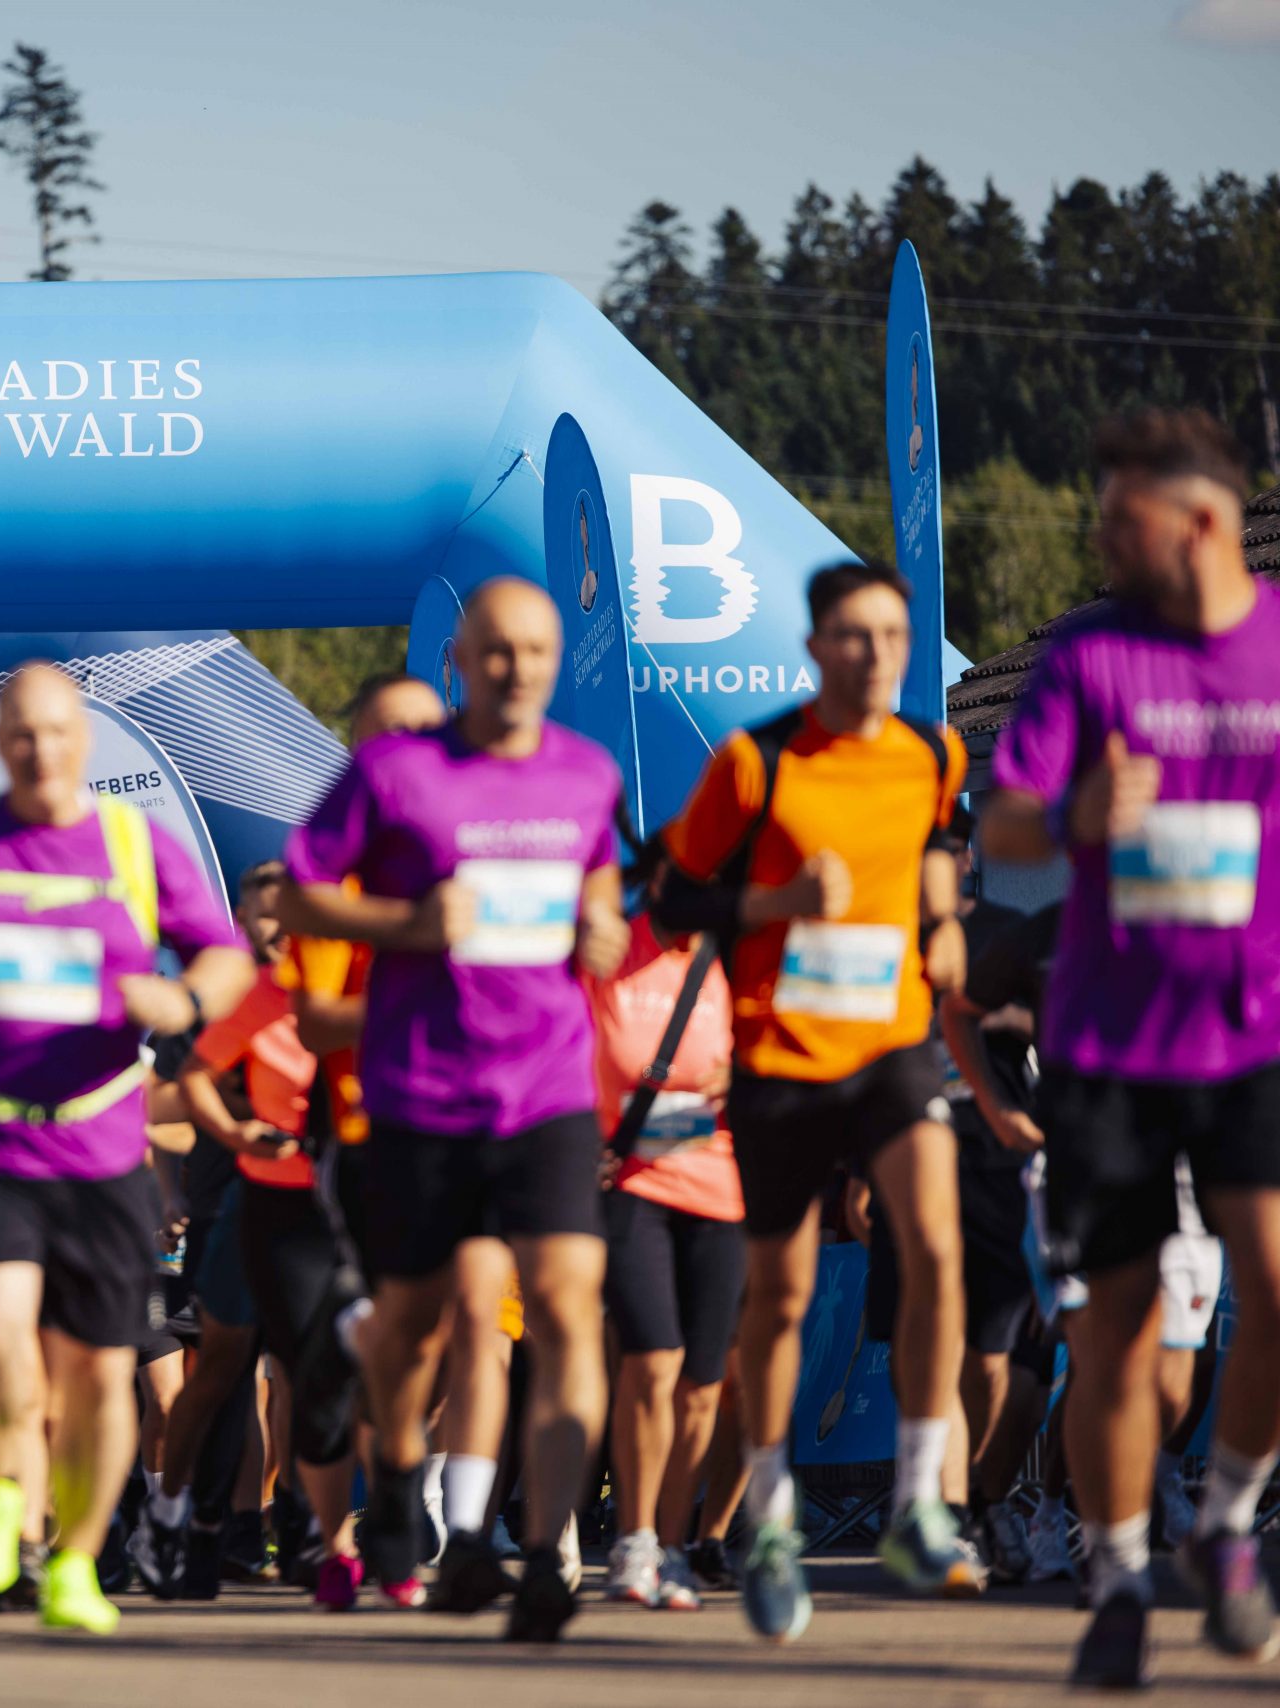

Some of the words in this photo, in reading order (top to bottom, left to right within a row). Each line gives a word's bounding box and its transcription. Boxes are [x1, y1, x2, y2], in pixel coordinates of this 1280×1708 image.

[627, 473, 761, 644] B
[630, 665, 818, 693] UPHORIA
[88, 770, 162, 797] IEBERS
